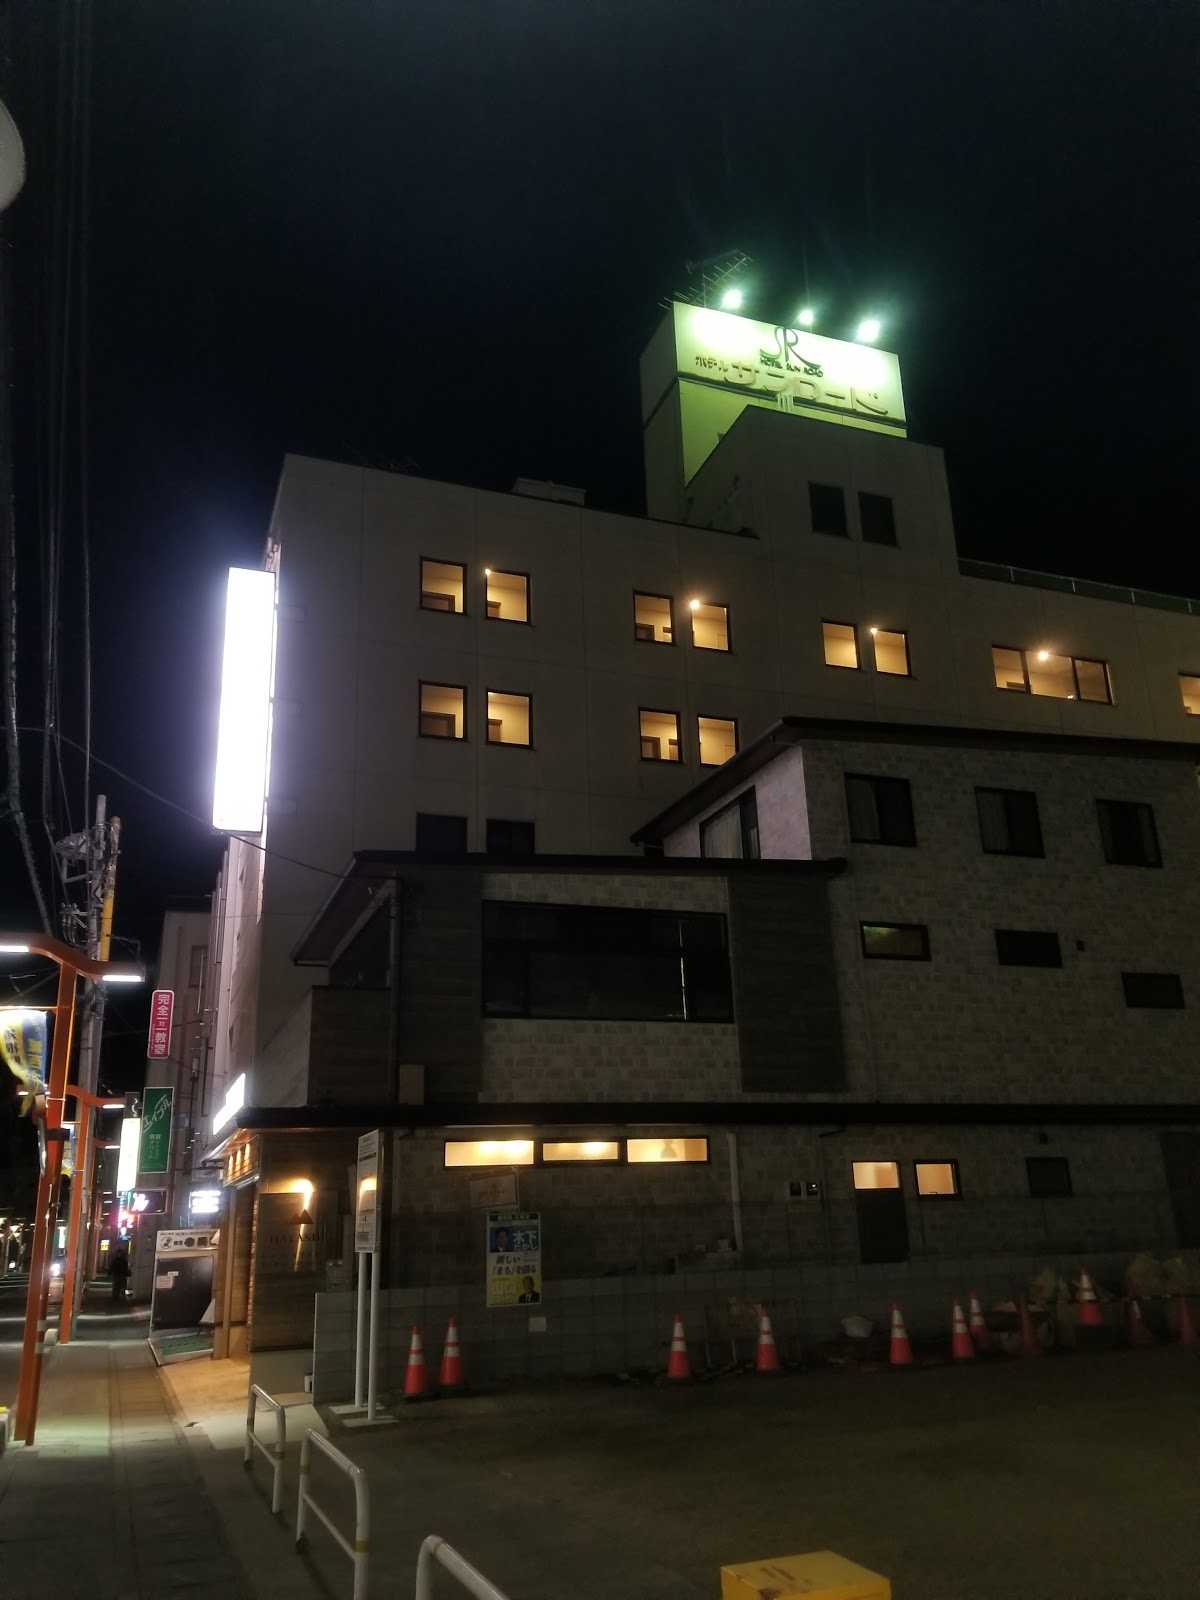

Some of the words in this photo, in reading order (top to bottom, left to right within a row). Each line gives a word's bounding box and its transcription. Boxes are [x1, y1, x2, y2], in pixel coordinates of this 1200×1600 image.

[760, 357, 783, 369] HOTEL
[786, 363, 800, 372] SUN
[803, 366, 823, 378] ROAD
